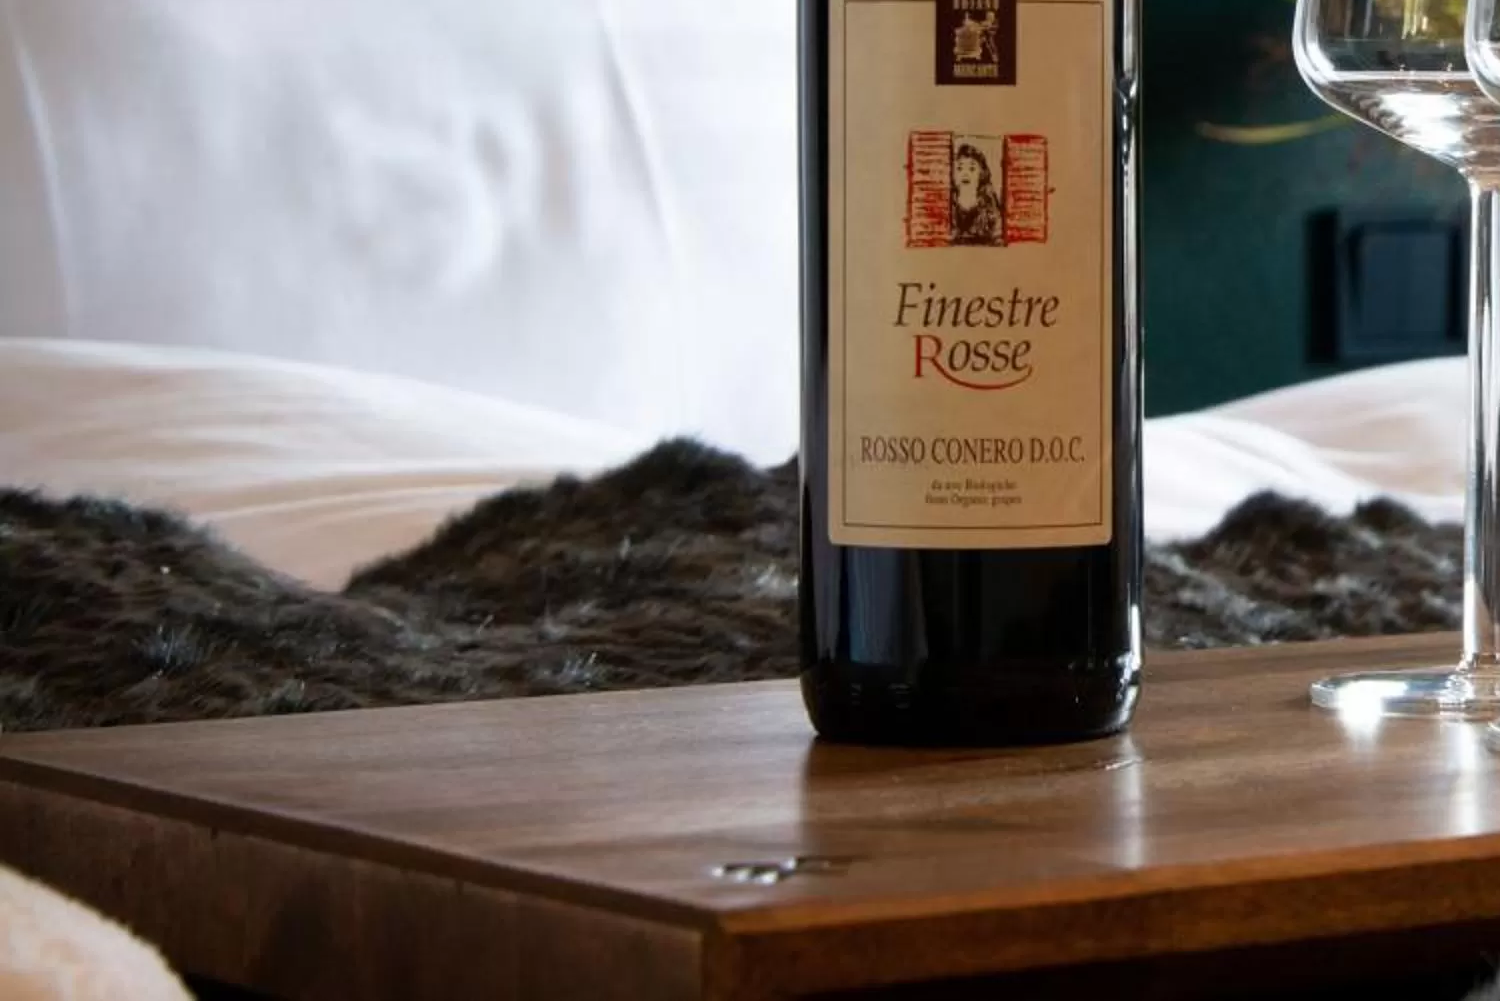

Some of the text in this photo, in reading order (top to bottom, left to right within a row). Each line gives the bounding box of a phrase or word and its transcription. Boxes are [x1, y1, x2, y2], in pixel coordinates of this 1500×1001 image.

[894, 282, 1060, 328] Finestre
[913, 333, 1033, 390] Rosse
[860, 435, 1085, 465] ROSSO CONERO D.O.C.
